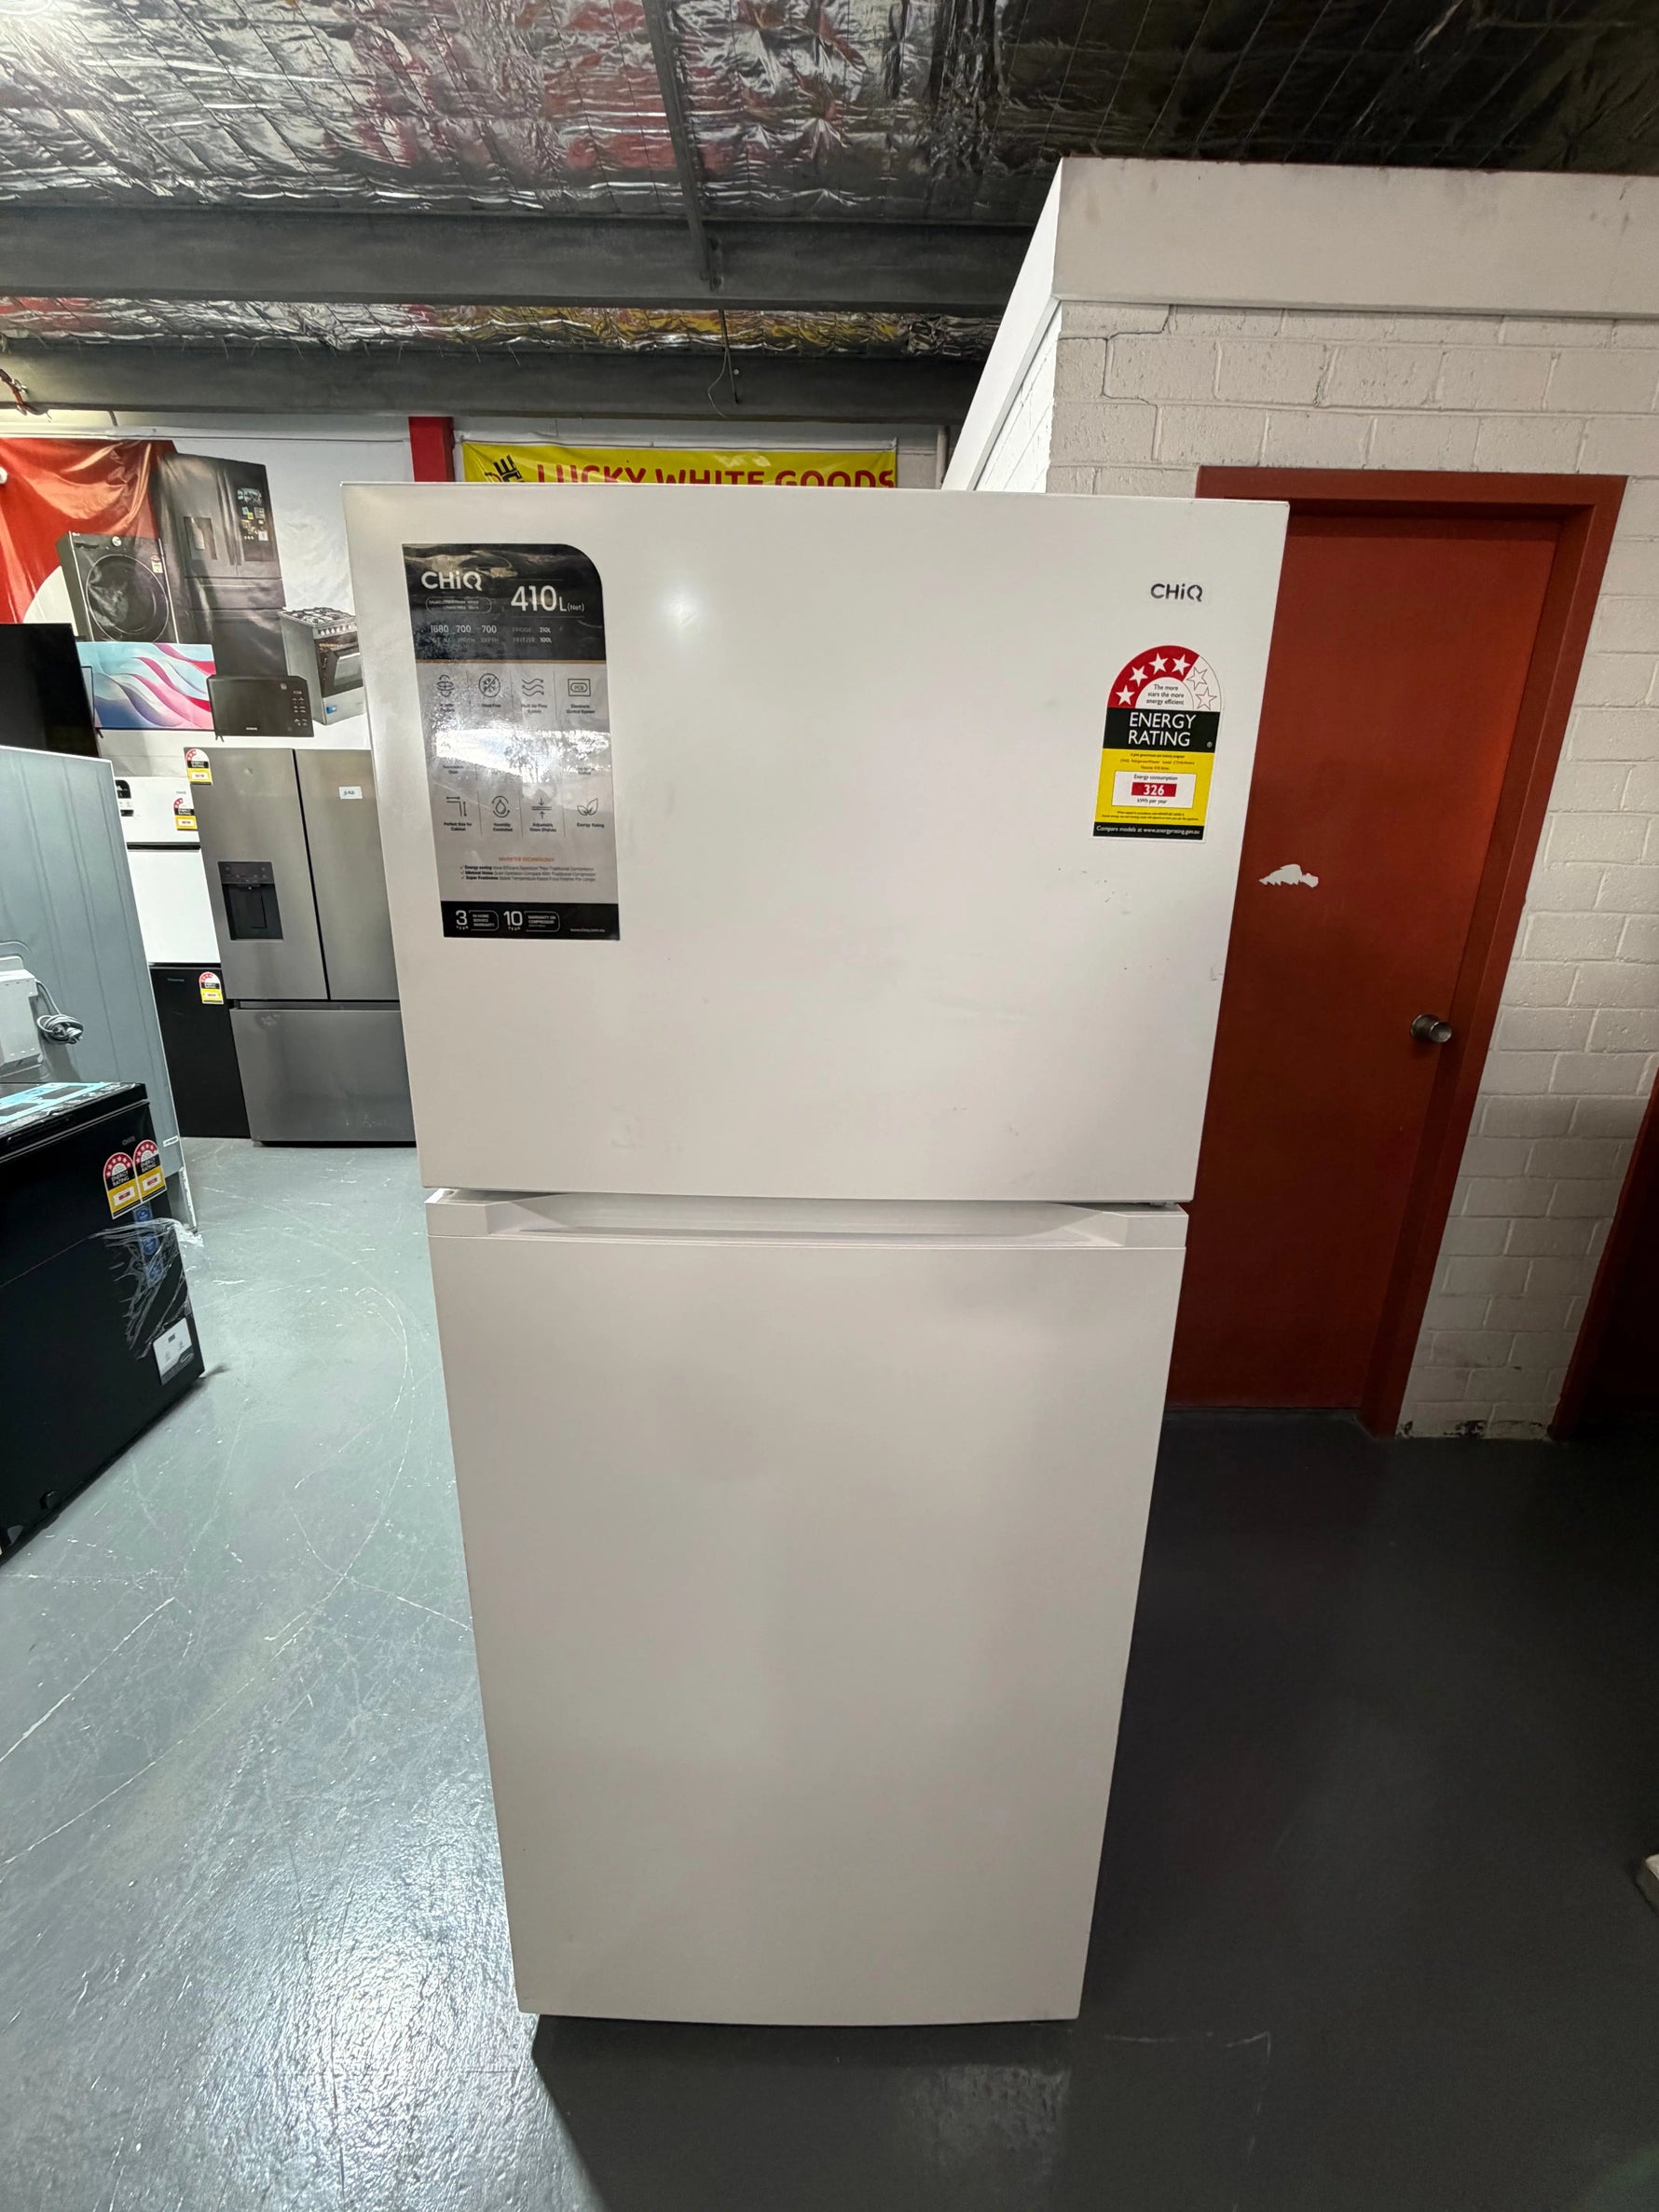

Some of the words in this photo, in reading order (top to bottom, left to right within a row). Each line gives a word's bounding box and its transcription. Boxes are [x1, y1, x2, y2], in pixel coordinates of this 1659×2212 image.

[421, 570, 483, 591] CHiQ
[1150, 583, 1203, 602] CHiQ
[456, 625, 472, 634] 700
[481, 625, 498, 634] 700
[1129, 711, 1197, 730] ENERGY
[1128, 729, 1191, 748] RATING
[1143, 784, 1165, 797] 326
[456, 910, 468, 926] 3
[503, 911, 523, 927] 10
